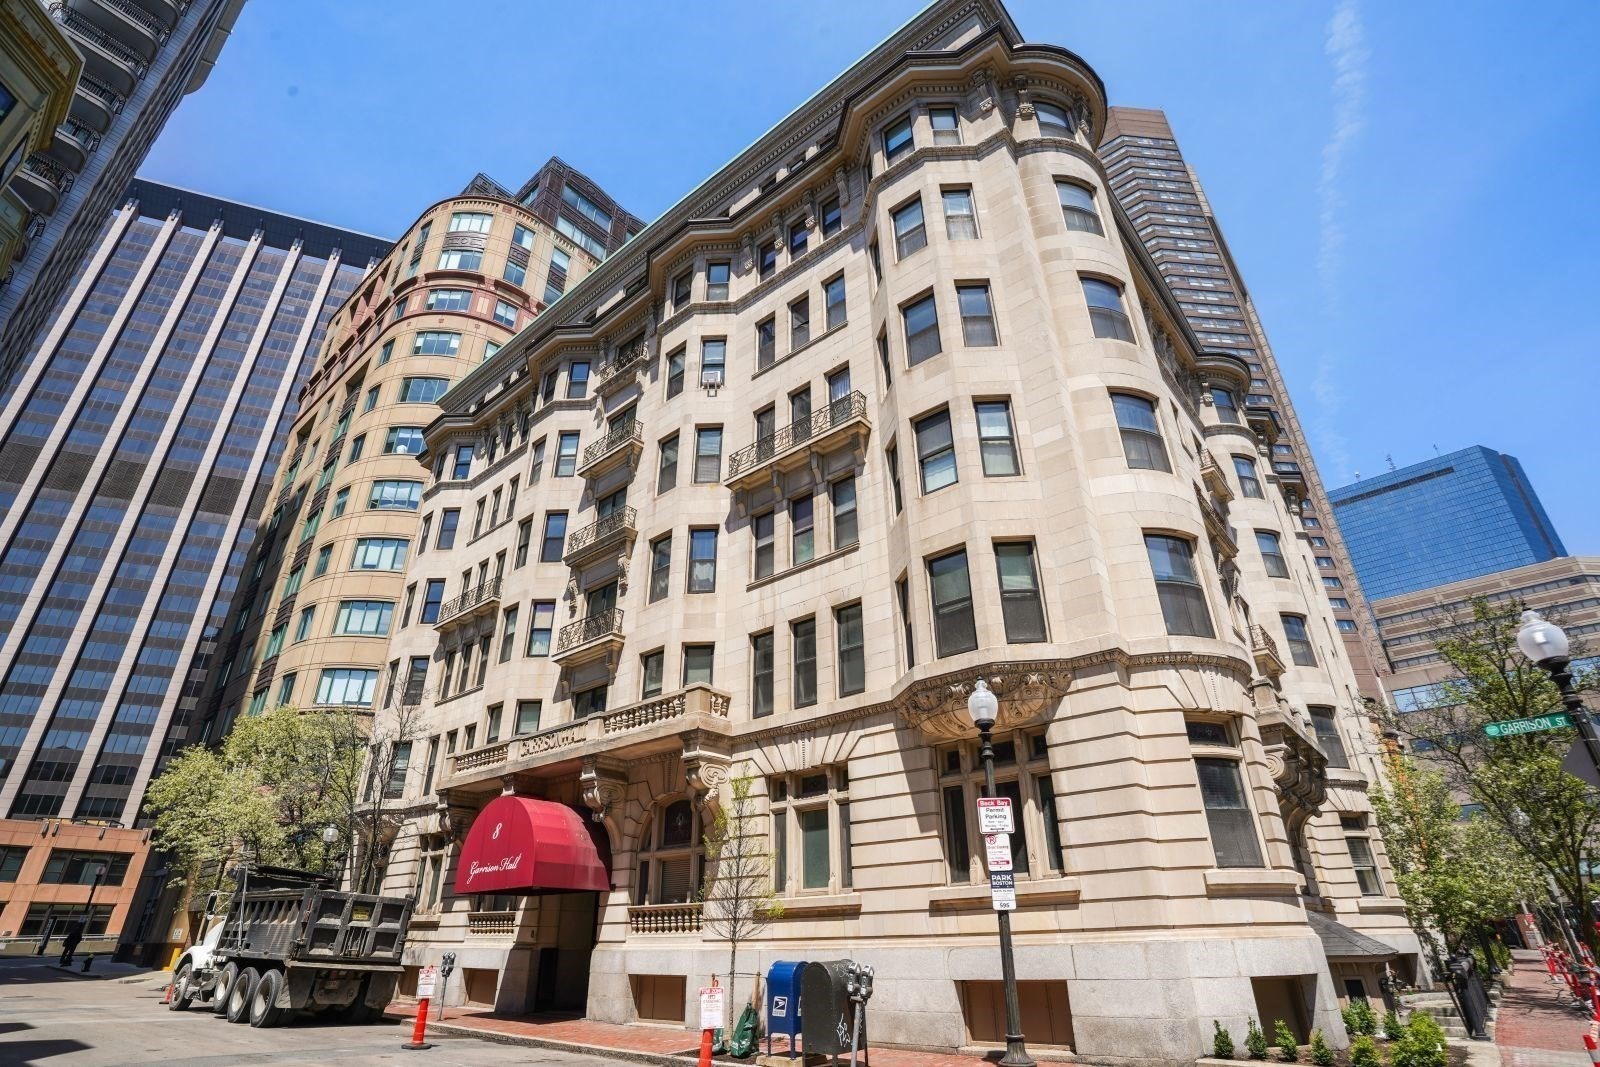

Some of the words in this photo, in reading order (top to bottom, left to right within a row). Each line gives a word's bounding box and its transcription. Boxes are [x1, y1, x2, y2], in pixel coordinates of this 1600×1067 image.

[1500, 717, 1552, 734] GARRISON
[1555, 716, 1567, 726] ST
[492, 822, 503, 840] 8
[466, 861, 499, 885] Garrison
[500, 853, 522, 872] Hall
